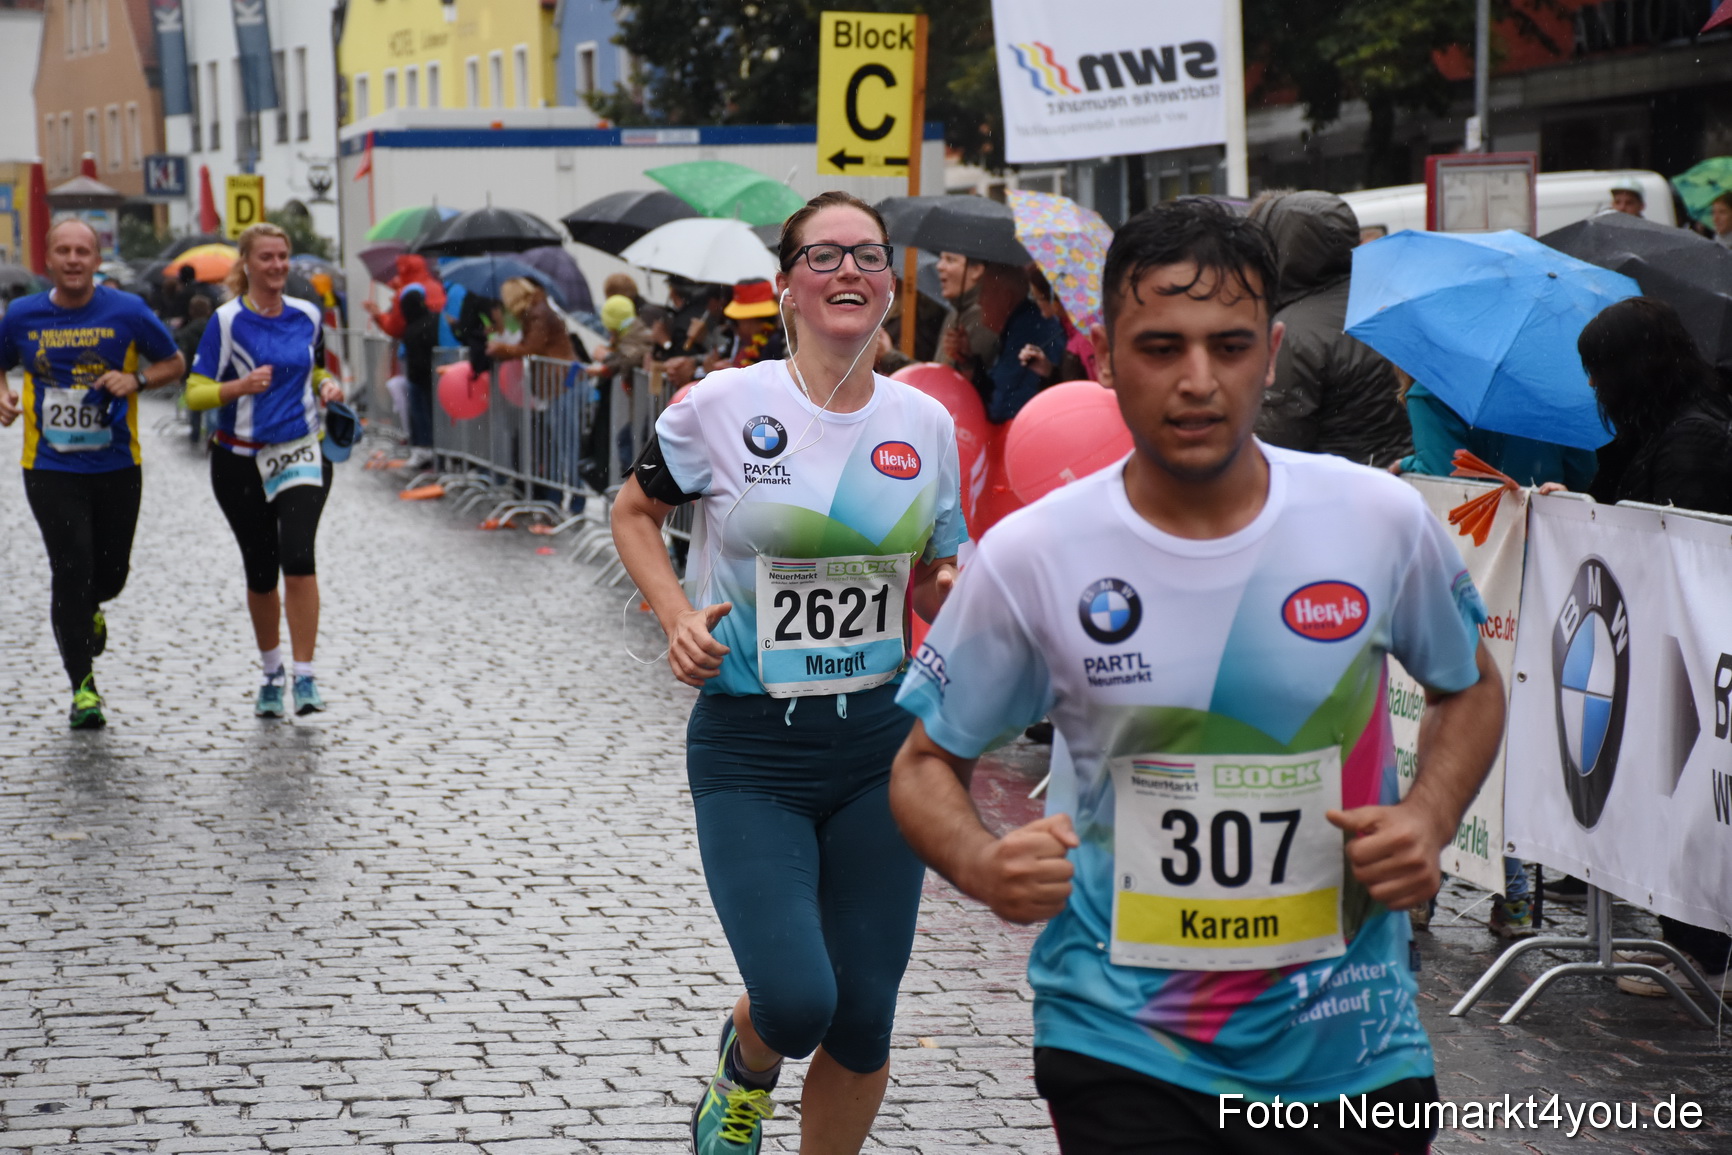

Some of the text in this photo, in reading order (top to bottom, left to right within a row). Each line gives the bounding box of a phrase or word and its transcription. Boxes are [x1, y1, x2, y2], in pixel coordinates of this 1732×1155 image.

[834, 20, 914, 49] Block
[845, 62, 897, 141] C
[236, 194, 255, 224] D
[747, 416, 784, 433] BMW
[743, 463, 791, 477] PARTL
[878, 450, 917, 470] Hervis
[744, 474, 792, 485] Neumarkt
[769, 572, 818, 580] NeuerMarkt
[827, 560, 898, 576] BOCK
[1083, 579, 1136, 603] BMW
[774, 584, 889, 642] 2621
[1294, 597, 1363, 626] Hervis
[1559, 564, 1629, 657] BMW
[764, 640, 771, 649] C
[806, 651, 867, 677] Margit
[1084, 653, 1152, 674] PARTL
[1088, 671, 1153, 688] Neumarkt
[1131, 775, 1199, 792] NeuerMarkt
[1213, 760, 1323, 789] BOCK
[1160, 809, 1302, 888] 307
[1123, 875, 1132, 890] B
[1180, 909, 1280, 940] Karam
